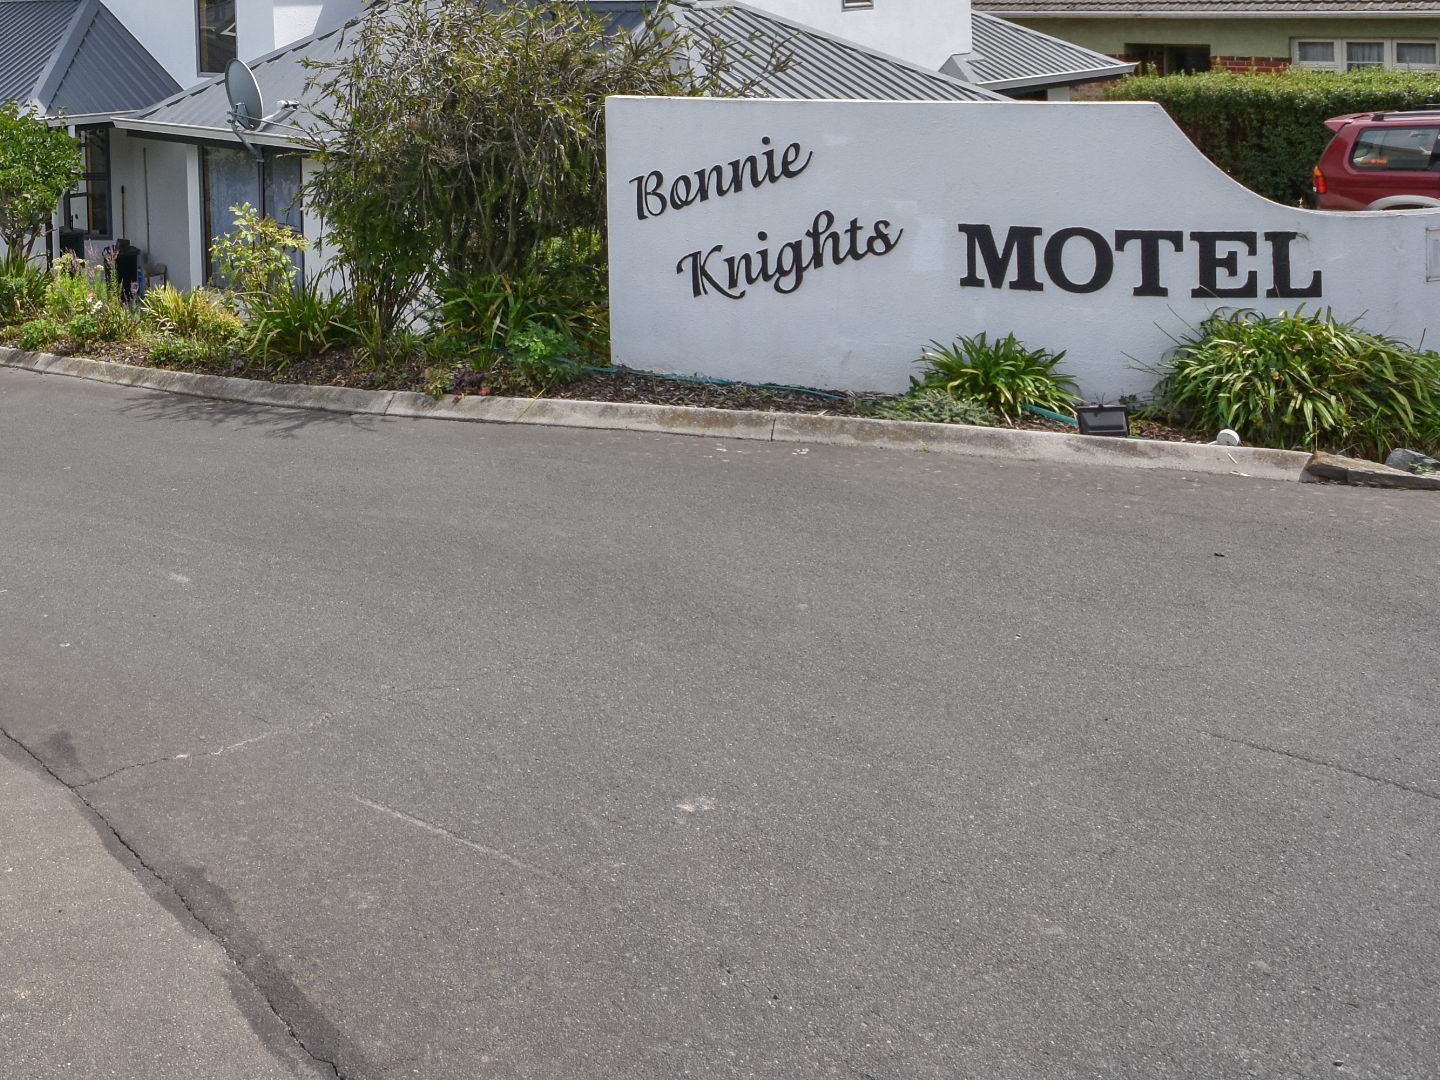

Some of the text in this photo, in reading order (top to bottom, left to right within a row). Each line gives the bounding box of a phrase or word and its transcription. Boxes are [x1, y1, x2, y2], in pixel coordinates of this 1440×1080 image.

[629, 136, 813, 220] Bonnie
[676, 210, 904, 300] Knights
[958, 223, 1322, 298] MOTEL
